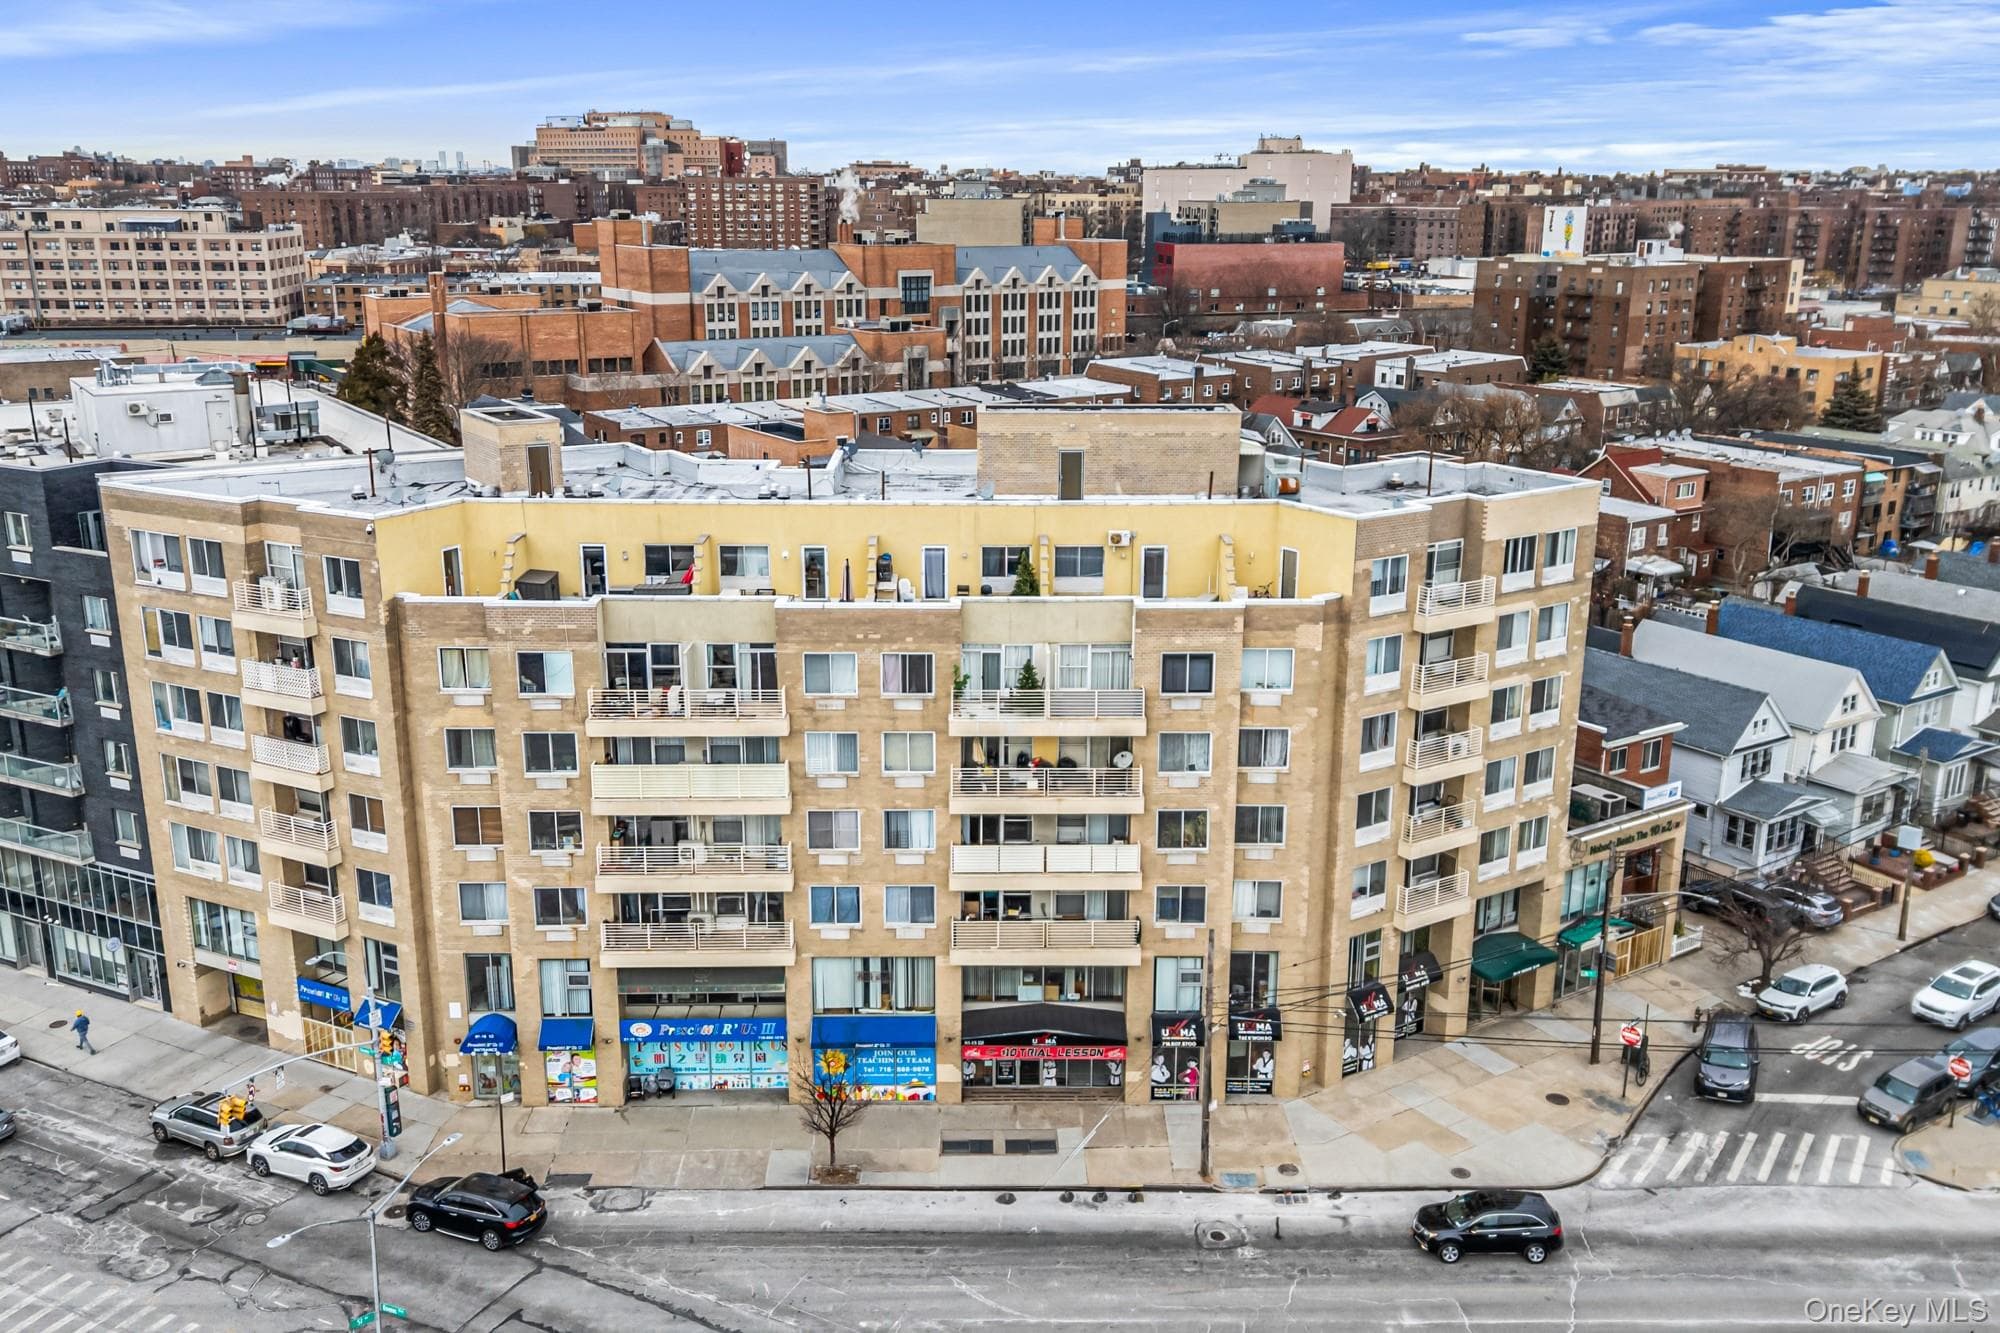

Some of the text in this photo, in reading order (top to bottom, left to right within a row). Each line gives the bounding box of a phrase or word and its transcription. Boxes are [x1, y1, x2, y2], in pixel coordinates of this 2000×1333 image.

[659, 1023, 719, 1036] Preschool
[874, 1050, 894, 1058] JOIN
[1020, 1048, 1052, 1057] TRIAL
[1057, 1048, 1105, 1057] LESSON
[1790, 1035, 1874, 1072] STOP
